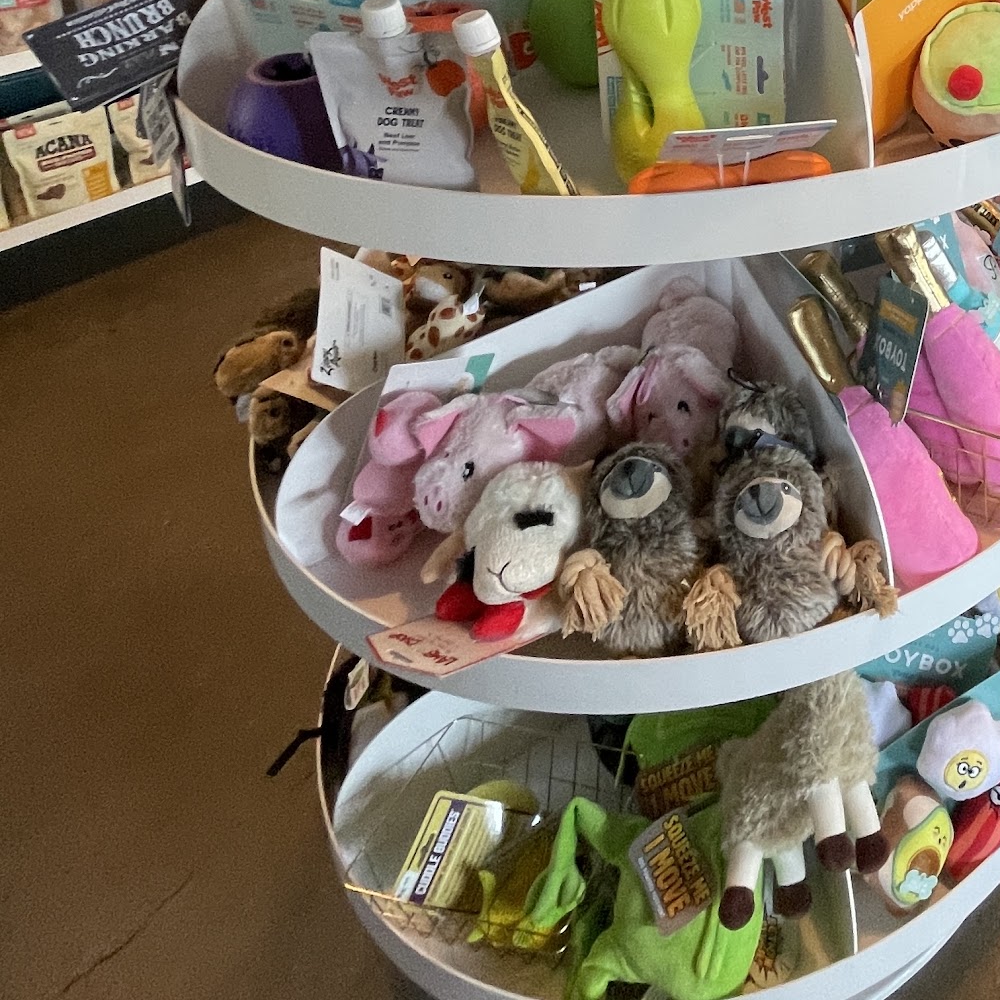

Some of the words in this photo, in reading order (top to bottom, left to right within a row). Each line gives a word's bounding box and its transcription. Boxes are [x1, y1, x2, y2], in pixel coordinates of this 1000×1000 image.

[752, 0, 763, 24] Paw
[77, 10, 191, 68] BARKING
[377, 117, 399, 127] DOG
[402, 118, 425, 128] TREAT
[35, 133, 94, 159] ACANA
[873, 331, 909, 373] TOYBOX
[872, 648, 969, 680] OYBOX
[642, 833, 666, 853] I
[662, 813, 701, 882] SQUEEZE
[689, 875, 711, 905] ME
[414, 853, 443, 896] CUDDLE
[647, 846, 692, 919] MOVE
